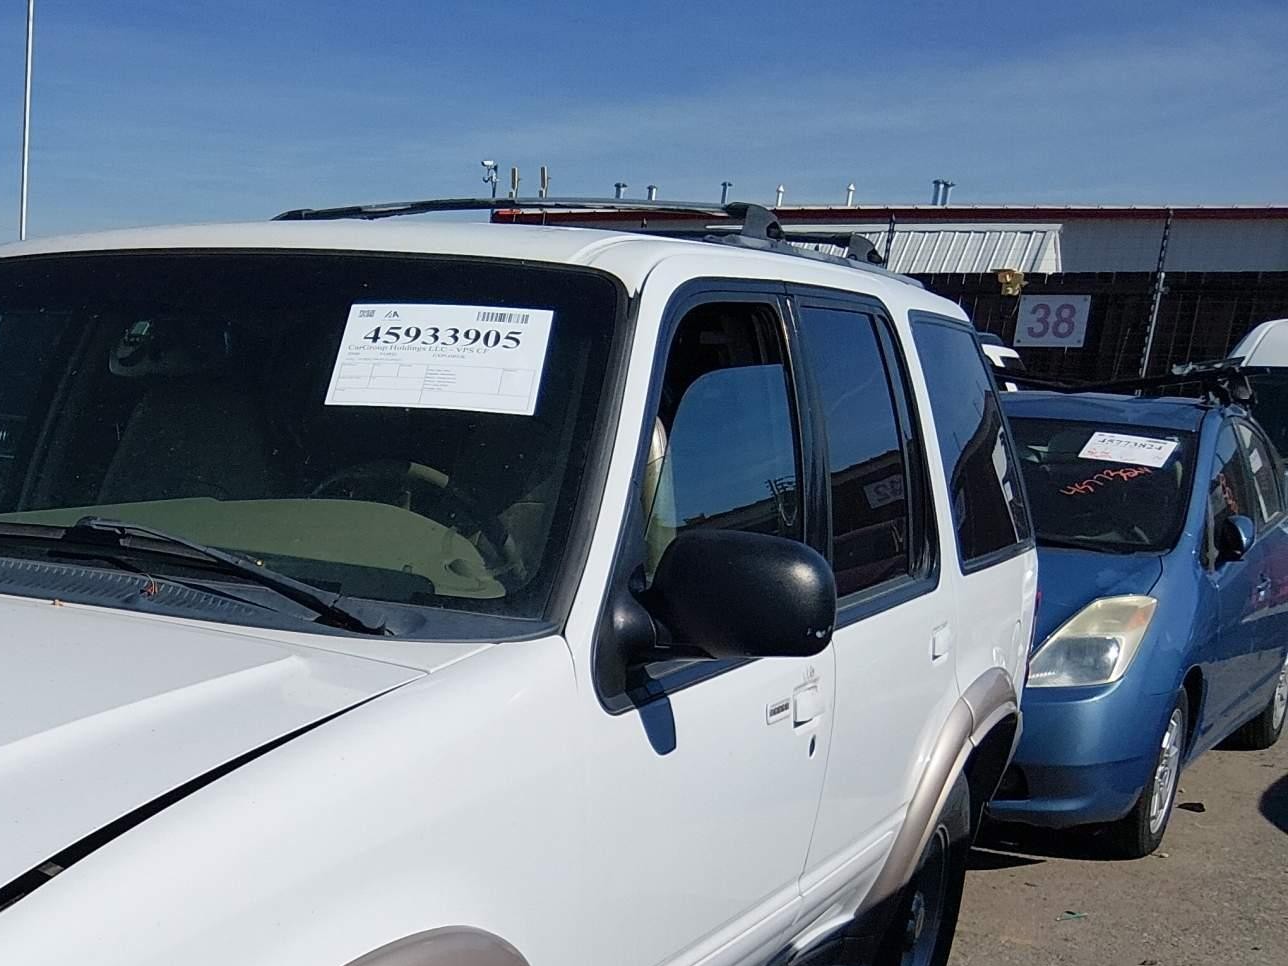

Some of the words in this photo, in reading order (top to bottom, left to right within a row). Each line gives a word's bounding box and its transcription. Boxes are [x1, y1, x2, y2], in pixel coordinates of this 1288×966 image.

[1027, 303, 1077, 339] 38
[348, 344, 388, 353] CarGroup
[390, 344, 427, 353] Holdings
[428, 345, 448, 353] LLC
[363, 326, 523, 350] 45933905
